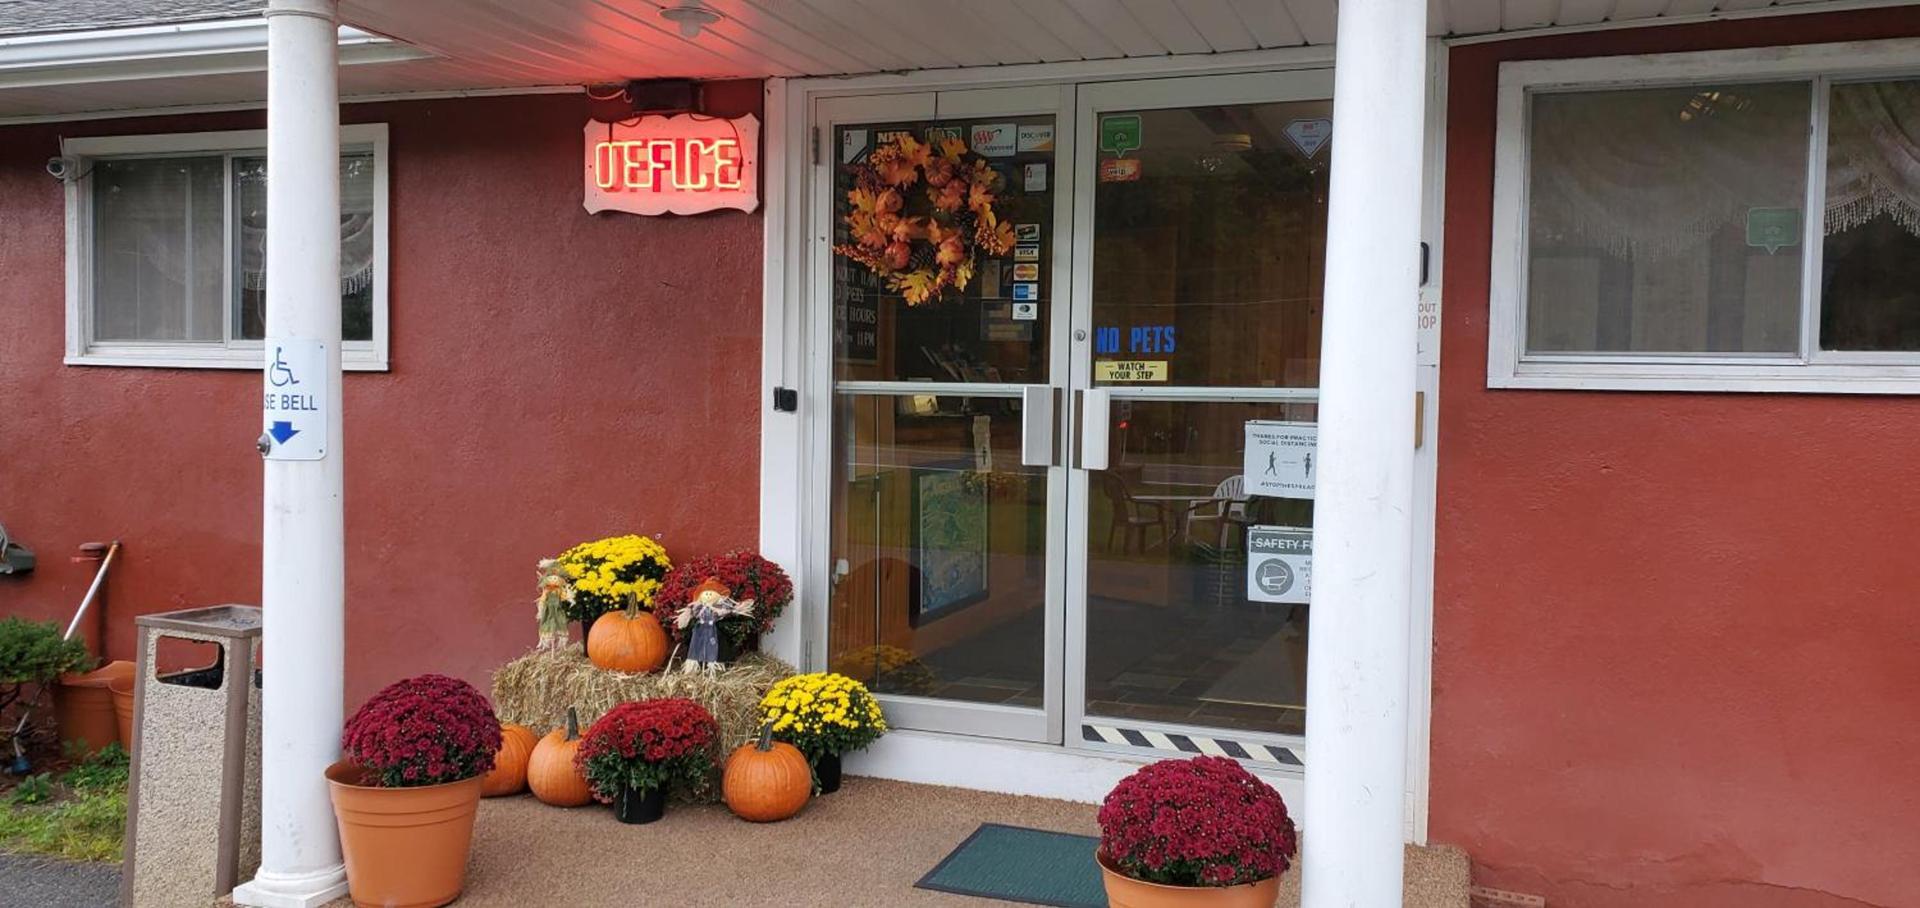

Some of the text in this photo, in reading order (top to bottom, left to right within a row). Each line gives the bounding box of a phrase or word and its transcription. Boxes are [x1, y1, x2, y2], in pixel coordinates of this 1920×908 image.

[595, 137, 742, 193] OFFICE
[849, 306, 876, 325] HOURS
[1418, 303, 1437, 313] OUT
[1095, 325, 1176, 353] NO PETS
[1117, 362, 1145, 371] WATCH
[1109, 371, 1154, 380] YOUR STEP
[281, 394, 318, 411] BELL
[1255, 537, 1299, 550] SAFETY
